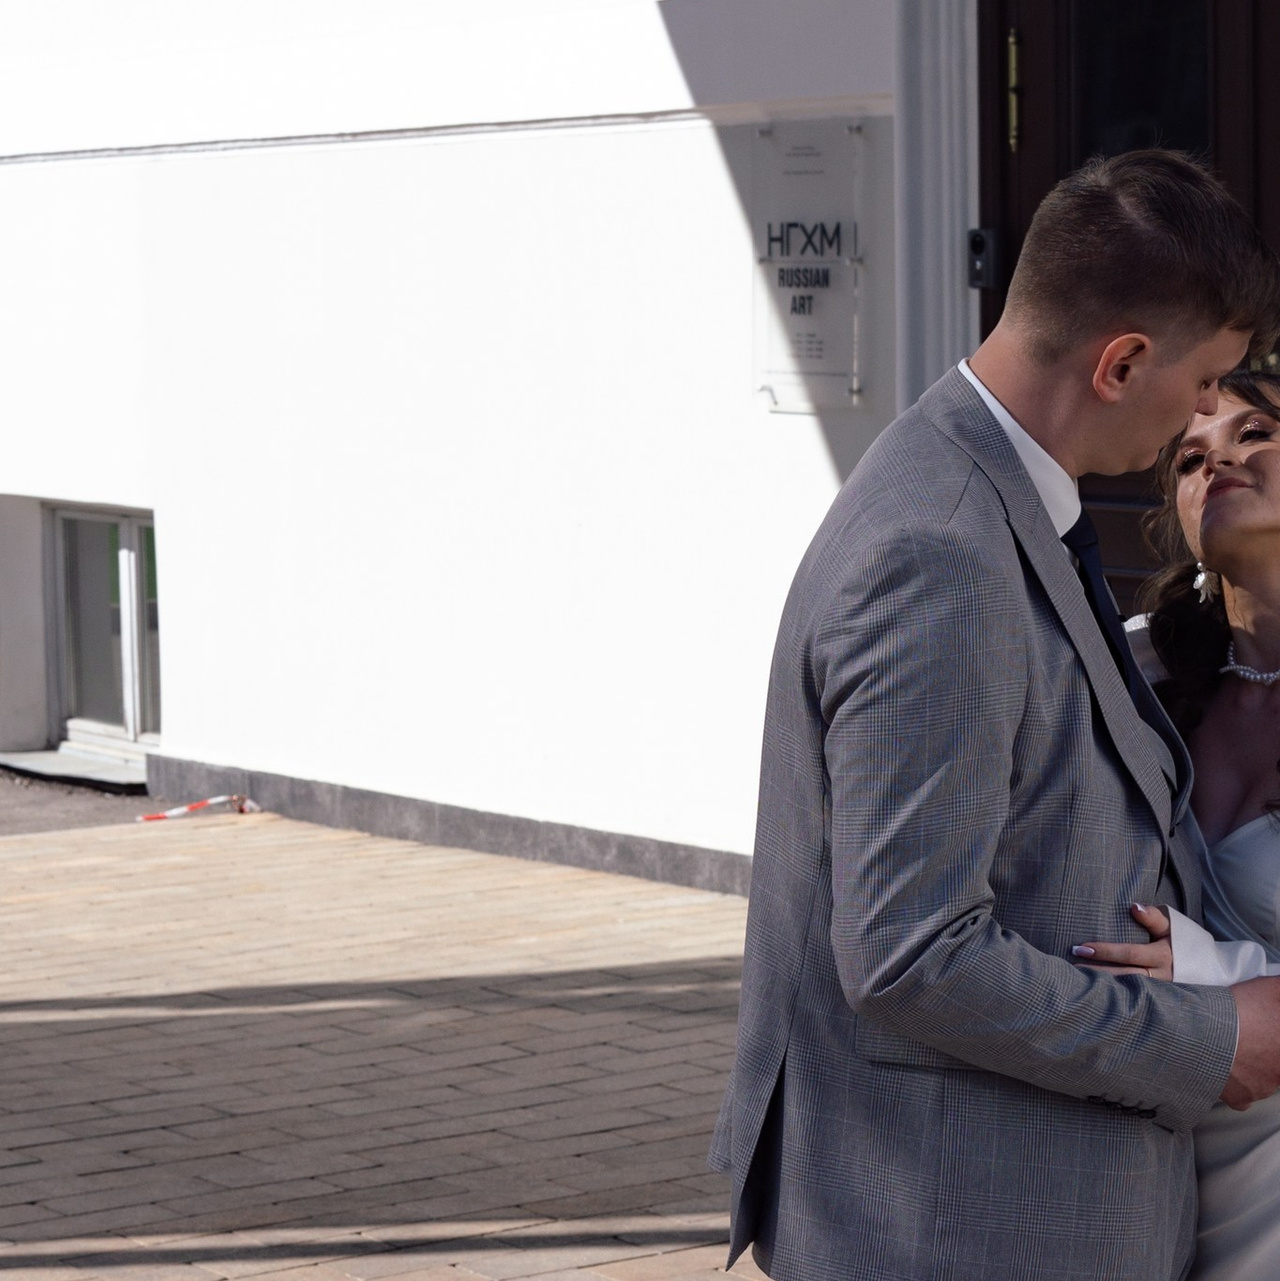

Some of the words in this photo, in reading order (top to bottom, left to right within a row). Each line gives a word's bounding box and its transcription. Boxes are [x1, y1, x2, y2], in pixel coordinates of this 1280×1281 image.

[767, 222, 842, 257] НГХМ
[778, 267, 830, 289] RUSSIAN
[790, 294, 814, 316] ART
